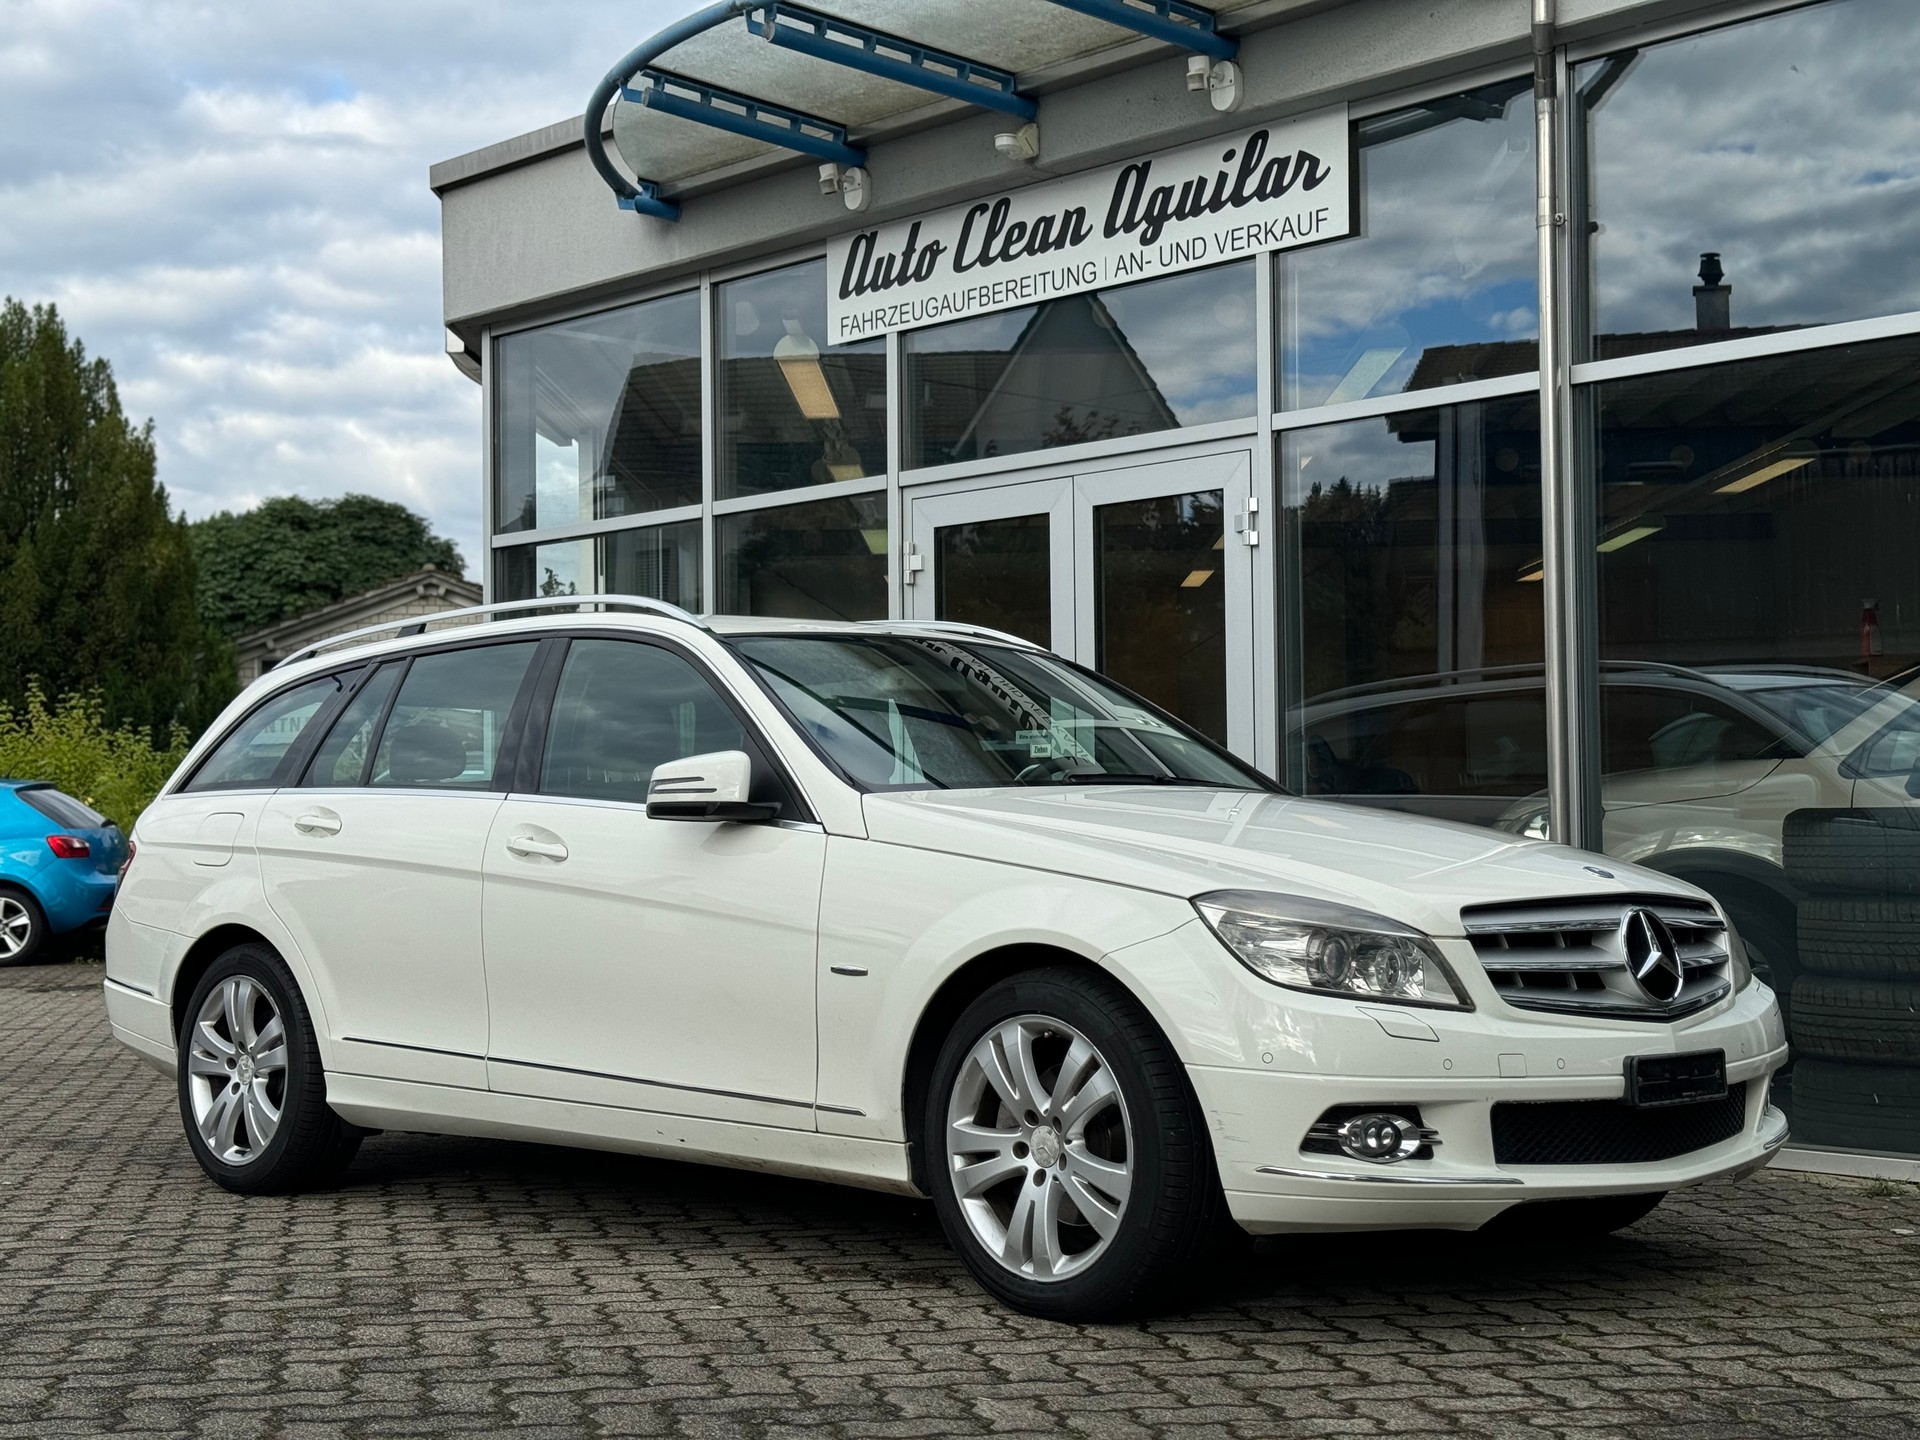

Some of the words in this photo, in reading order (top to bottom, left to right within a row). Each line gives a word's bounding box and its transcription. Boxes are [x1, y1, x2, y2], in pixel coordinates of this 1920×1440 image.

[837, 221, 947, 300] Auto
[952, 197, 1093, 274] Clean
[1103, 129, 1332, 246] Aguilar
[840, 261, 1098, 338] FAHRZEUGAUFBEREITUNG
[1114, 250, 1153, 278] AN-
[1159, 237, 1208, 269] UND
[1215, 207, 1330, 255] VERKAUF
